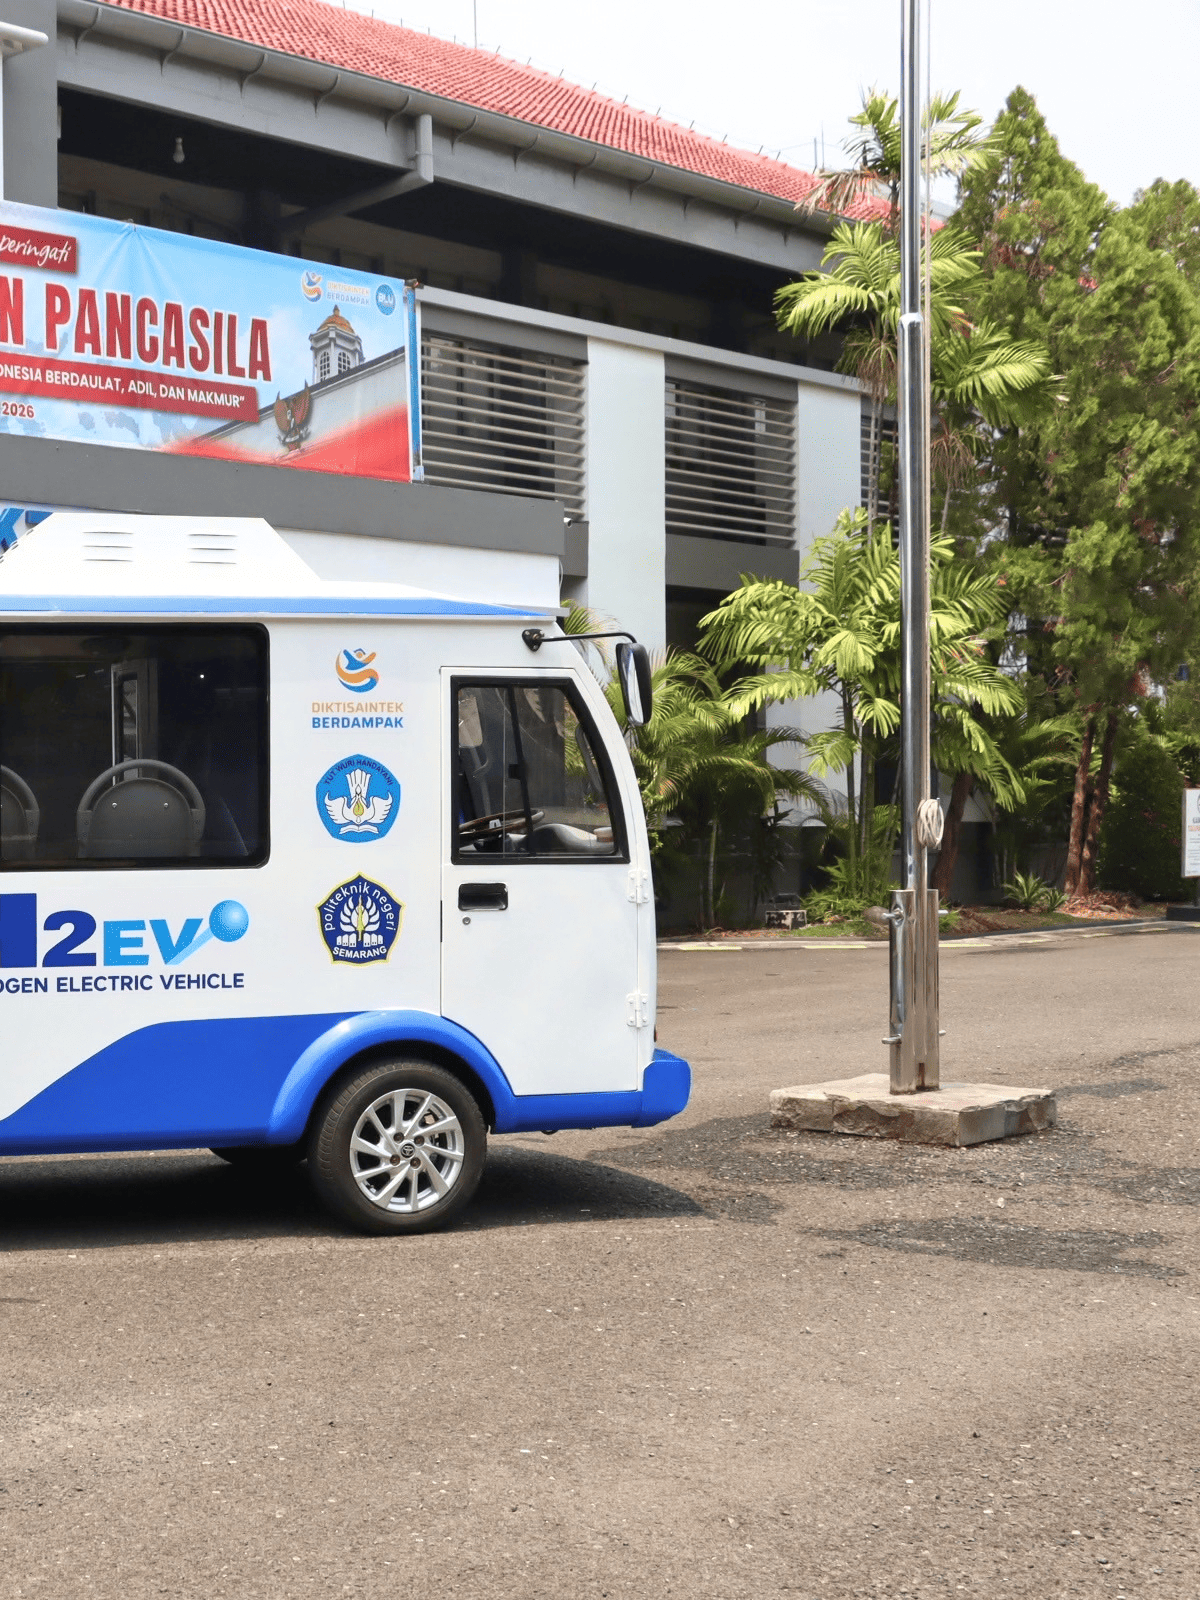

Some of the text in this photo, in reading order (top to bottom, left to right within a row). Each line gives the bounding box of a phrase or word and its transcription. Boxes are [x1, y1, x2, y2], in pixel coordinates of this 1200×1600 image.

[45, 282, 272, 382] PANCASILA
[45, 370, 125, 394] BERDAULAT,
[128, 380, 157, 398] ADIL,
[159, 386, 185, 401] DAN
[187, 388, 245, 408] MAKMUR”
[1, 402, 35, 418] 2026
[311, 702, 404, 713] DIKTISAINTEK
[312, 717, 404, 729] BERDAMPAK
[324, 759, 394, 786] TUT WURI HANDAYANI
[324, 882, 397, 931] politeknik negeri
[332, 946, 387, 959] SEMARANG
[56, 974, 153, 993] ELECTRIC
[159, 972, 245, 990] VEHICLE
